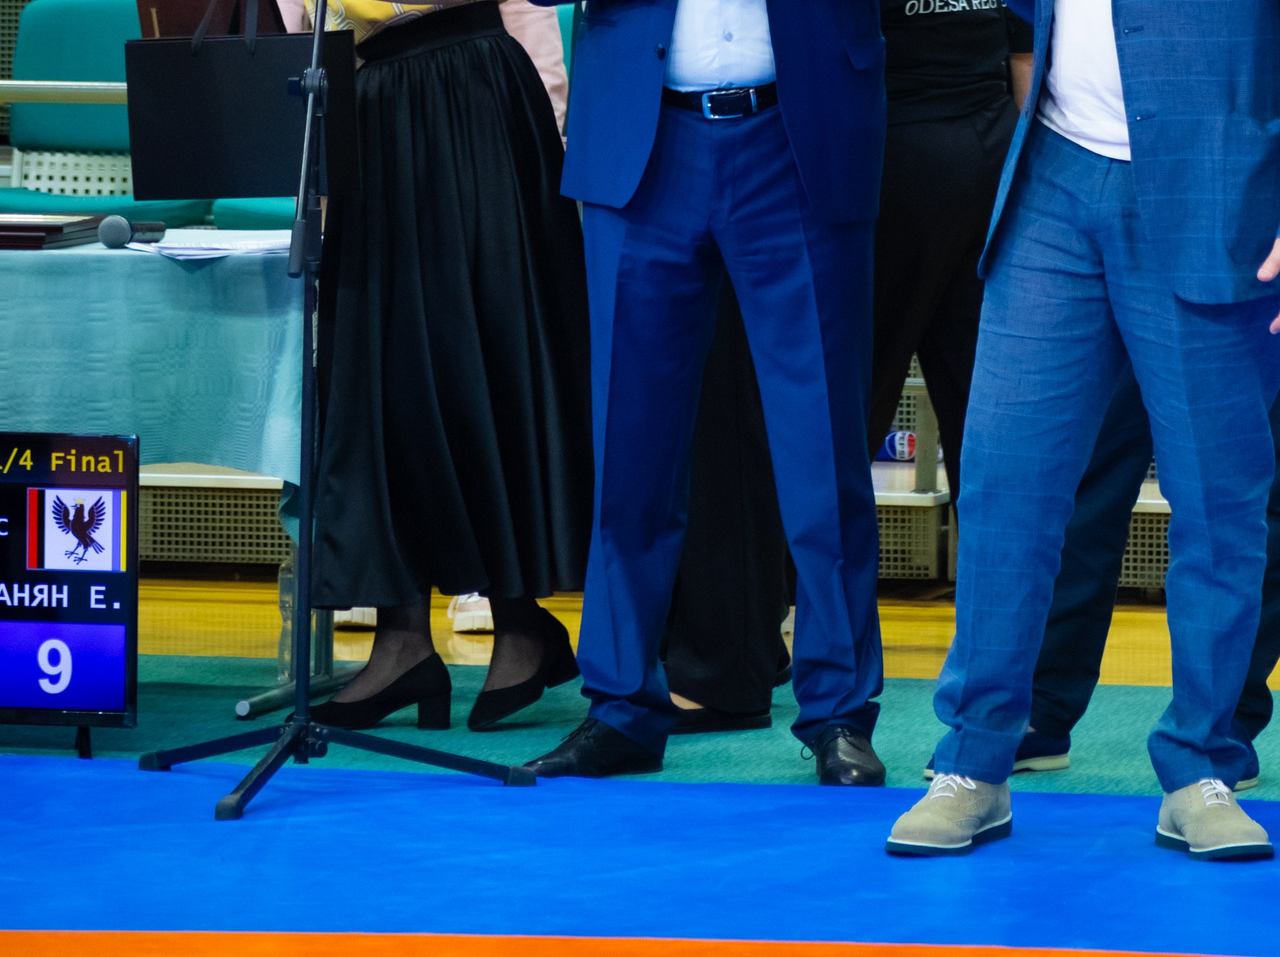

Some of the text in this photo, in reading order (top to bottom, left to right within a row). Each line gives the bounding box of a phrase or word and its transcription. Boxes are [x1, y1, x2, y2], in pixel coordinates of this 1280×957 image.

[0, 447, 124, 474] /4 Final
[37, 639, 73, 694] 9
